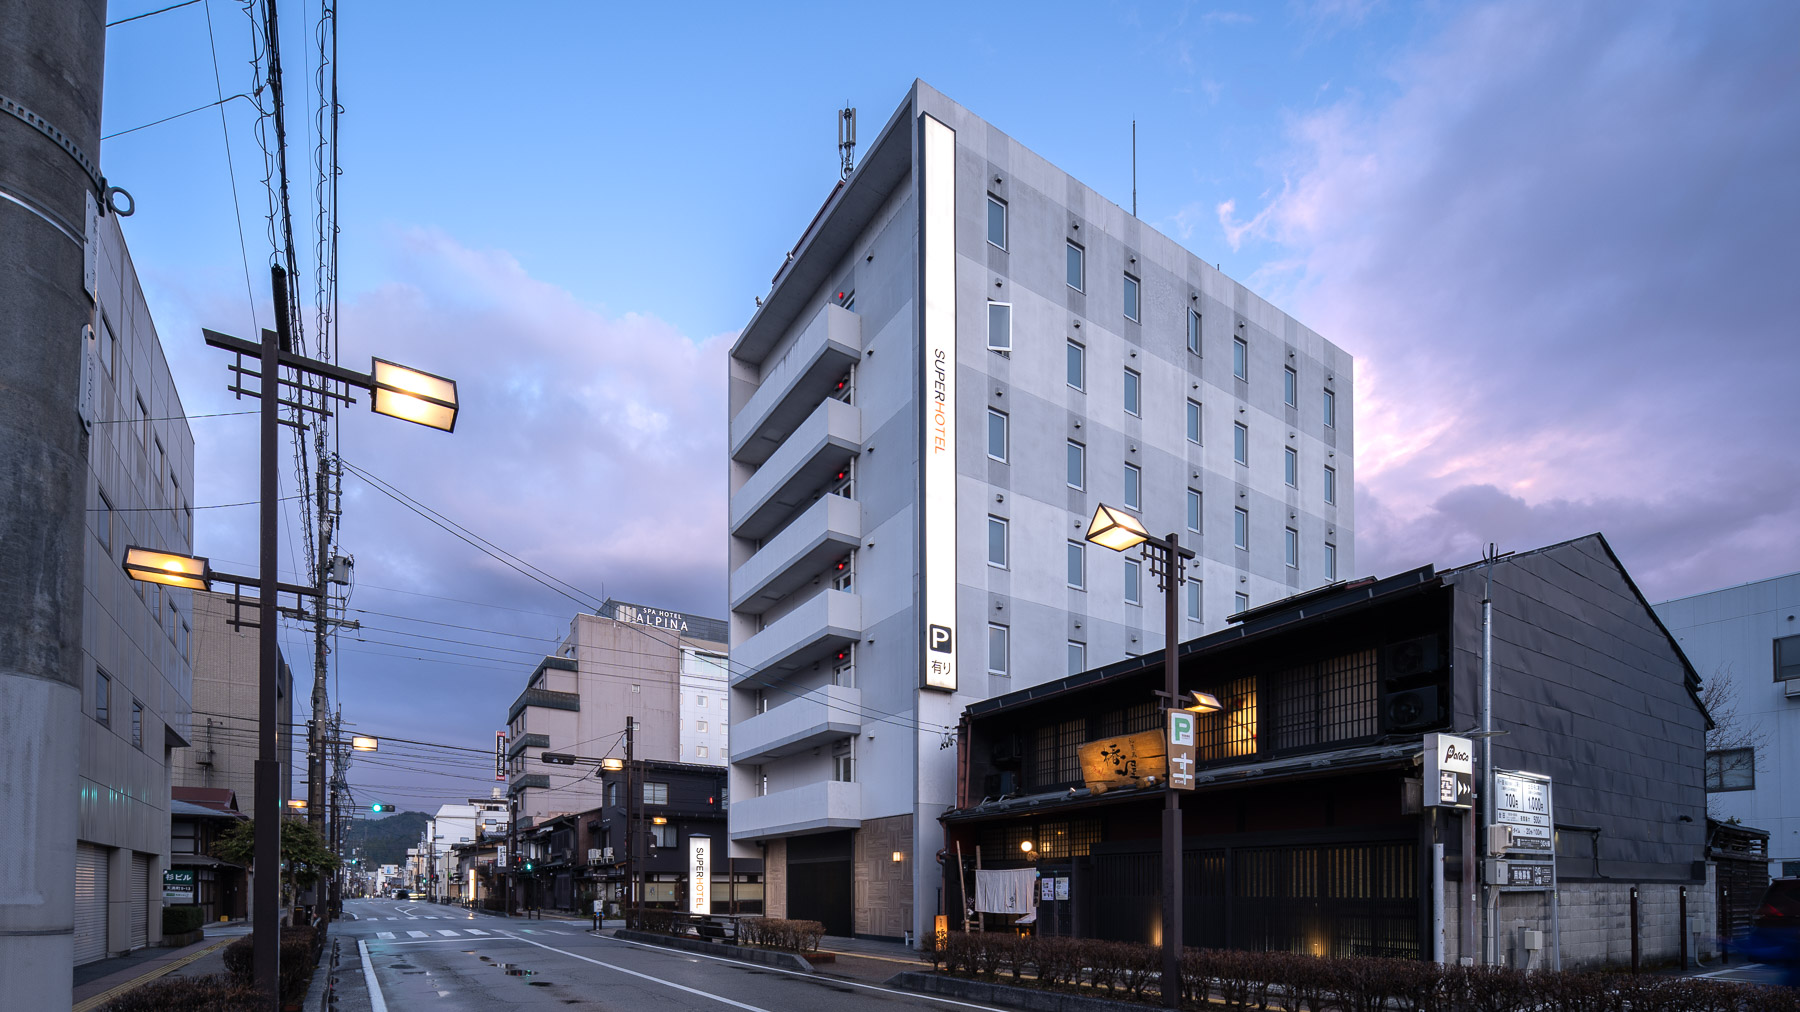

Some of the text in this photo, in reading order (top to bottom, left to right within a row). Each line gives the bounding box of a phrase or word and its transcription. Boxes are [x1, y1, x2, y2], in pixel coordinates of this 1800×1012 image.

[642, 607, 682, 620] SPA HOTEL
[636, 613, 689, 632] ALPINA
[932, 627, 950, 649] P
[931, 660, 951, 675] 有り
[1174, 717, 1191, 741] P
[165, 873, 192, 881] 杉ビル
